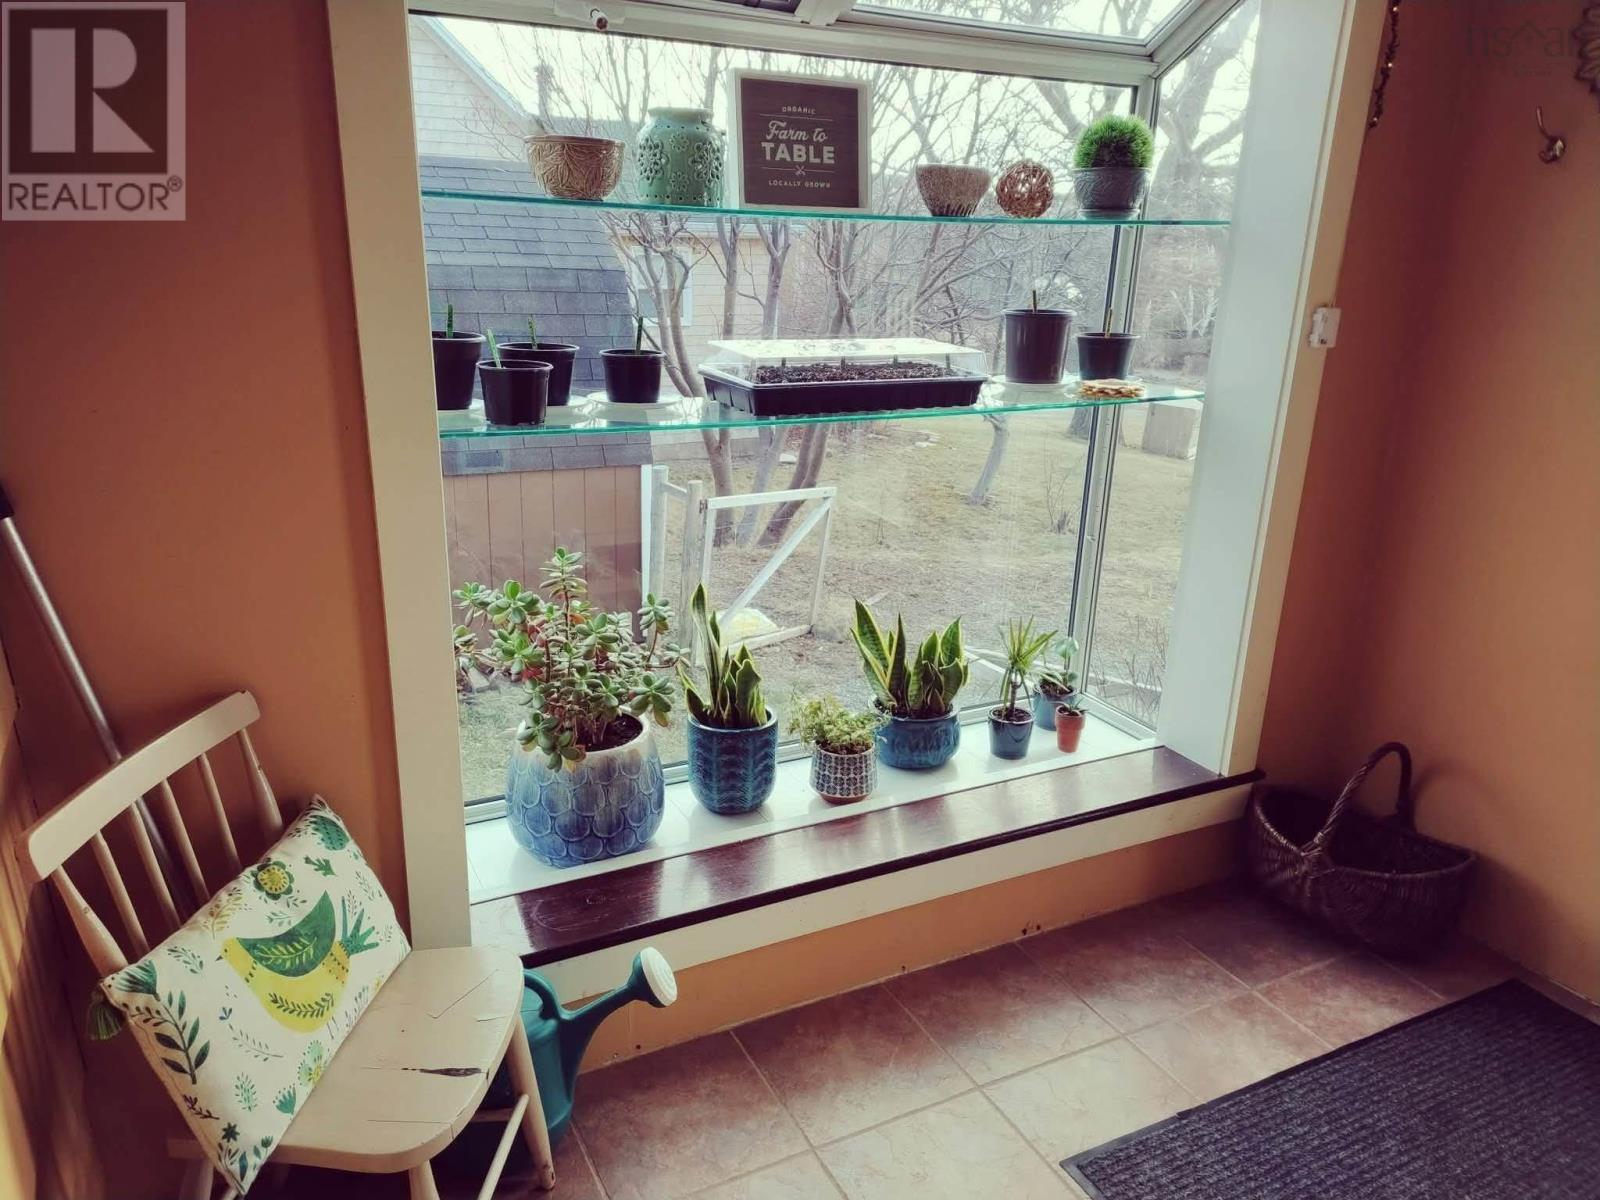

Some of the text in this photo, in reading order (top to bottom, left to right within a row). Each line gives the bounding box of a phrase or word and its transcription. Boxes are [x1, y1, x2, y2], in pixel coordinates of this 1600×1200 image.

[782, 105, 816, 115] ORGANIC
[765, 120, 828, 143] Farm to
[761, 142, 835, 164] TABLE
[768, 179, 831, 188] LOCALLY GROWN
